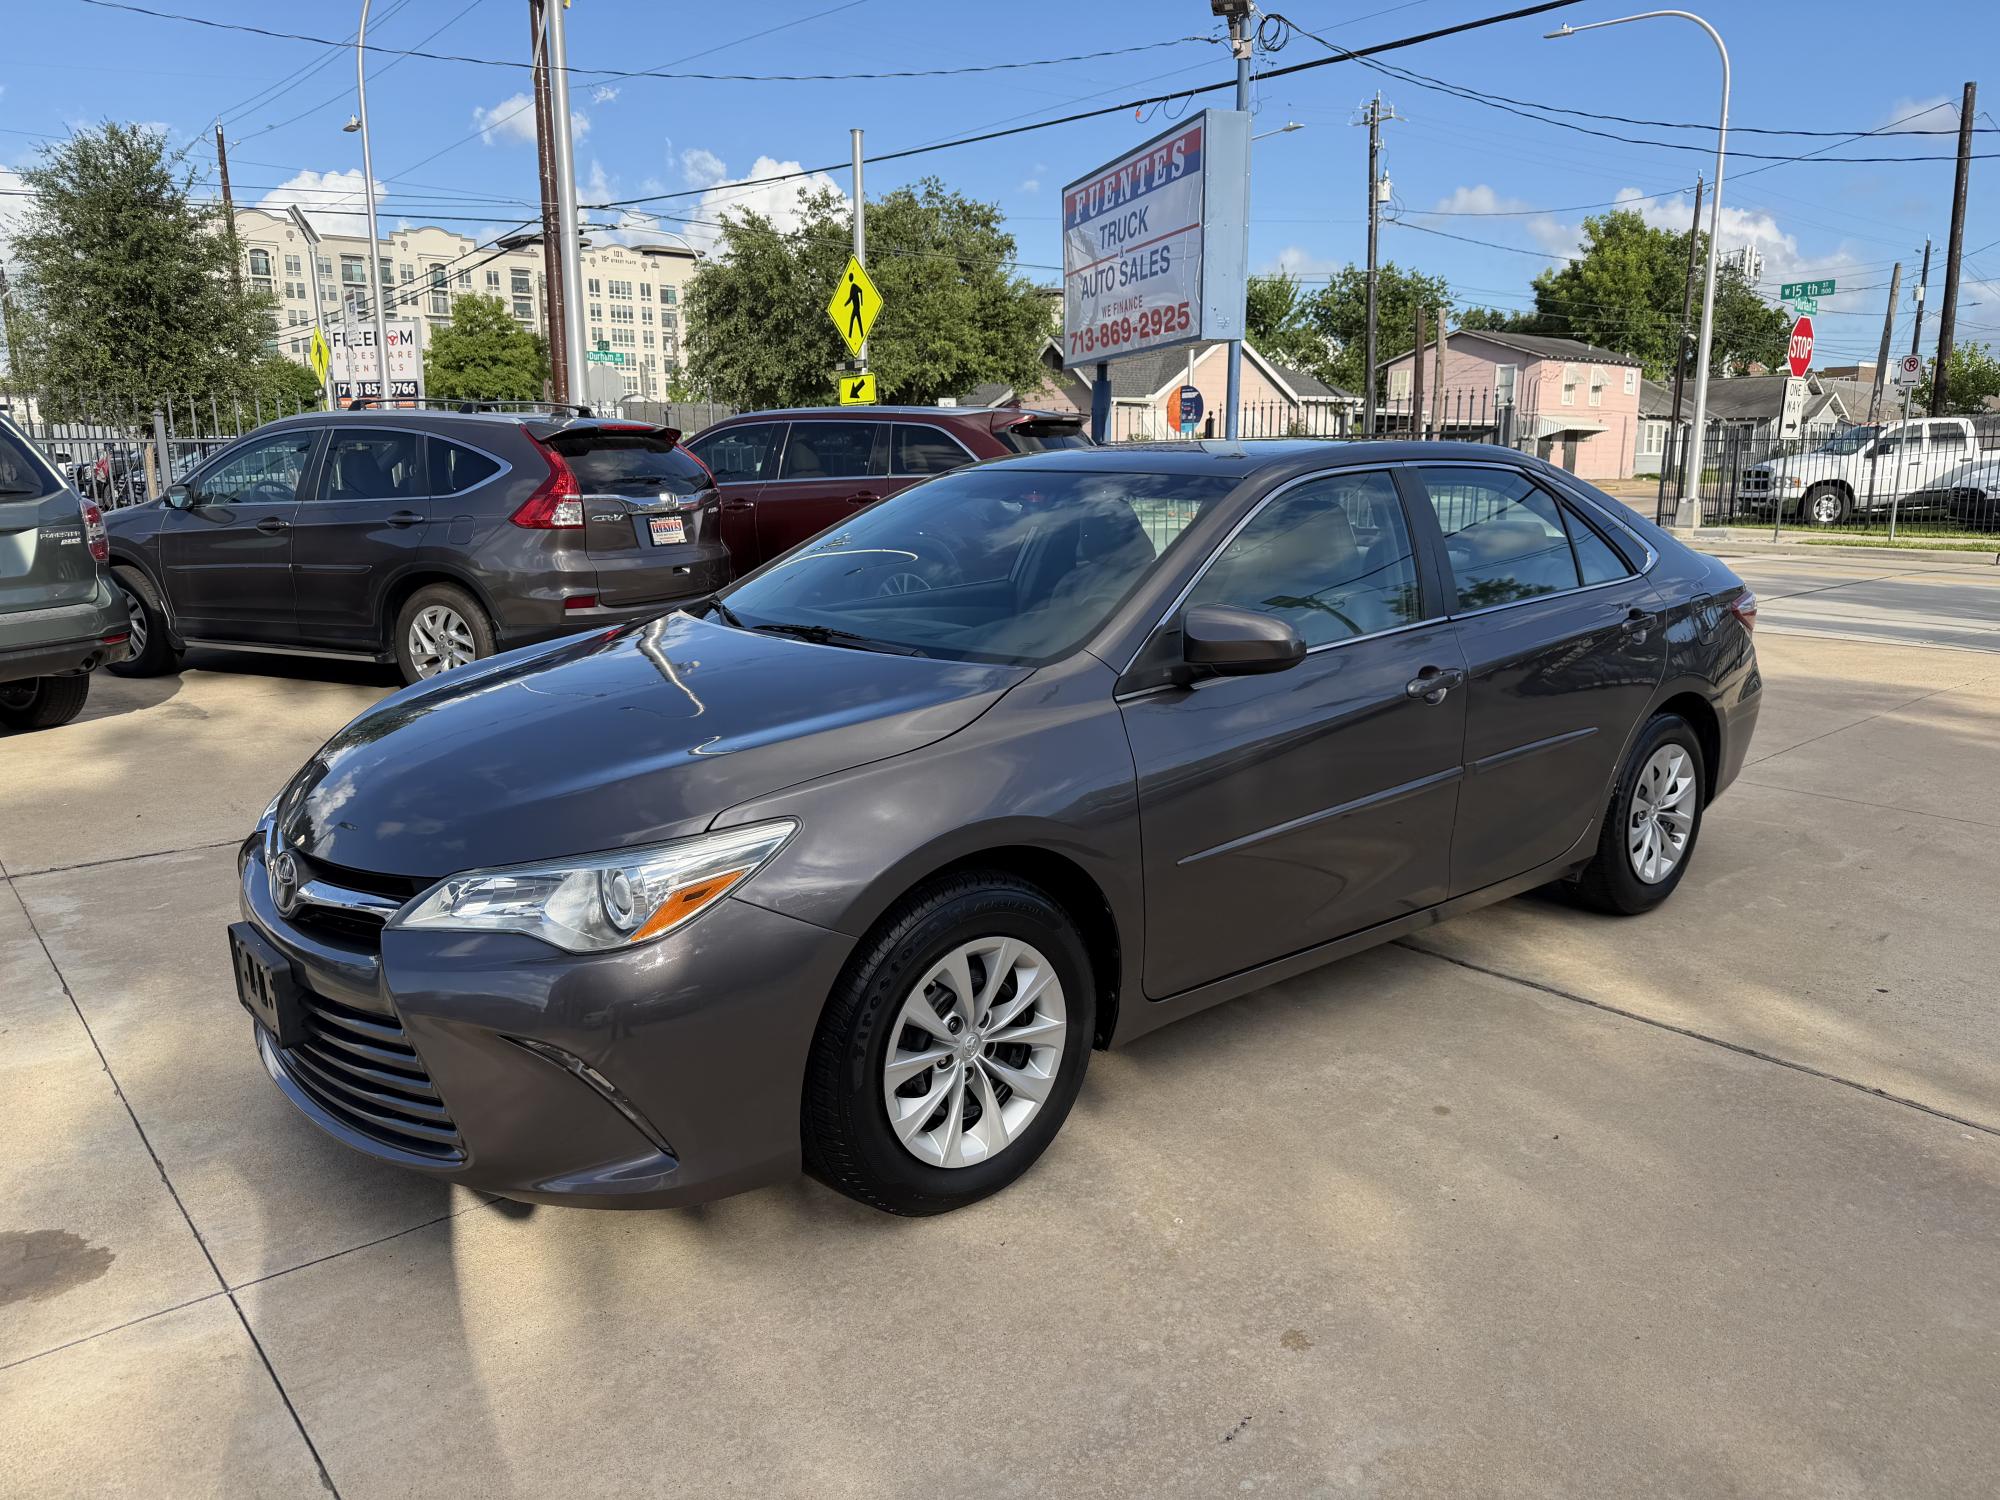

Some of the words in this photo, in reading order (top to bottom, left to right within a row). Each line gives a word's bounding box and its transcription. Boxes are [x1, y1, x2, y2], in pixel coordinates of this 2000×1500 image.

[1075, 139, 1185, 224] FUENTES
[1100, 205, 1149, 250] TRUCK
[1081, 265, 1115, 301] AUTO
[1119, 245, 1170, 287] SALES
[1792, 285, 1803, 297] 15
[1101, 304, 1112, 319] WE
[1113, 295, 1143, 315] FINANCE
[1070, 302, 1190, 355] 713-869-2925
[1790, 335, 1812, 358] STOP
[589, 352, 614, 361] Durham
[364, 382, 415, 395] 8579766
[1790, 384, 1802, 397] ONE
[1787, 401, 1802, 413] WAY
[591, 514, 624, 522] CR-V
[653, 521, 681, 533] FUENTES
[40, 531, 80, 539] FORESTER
